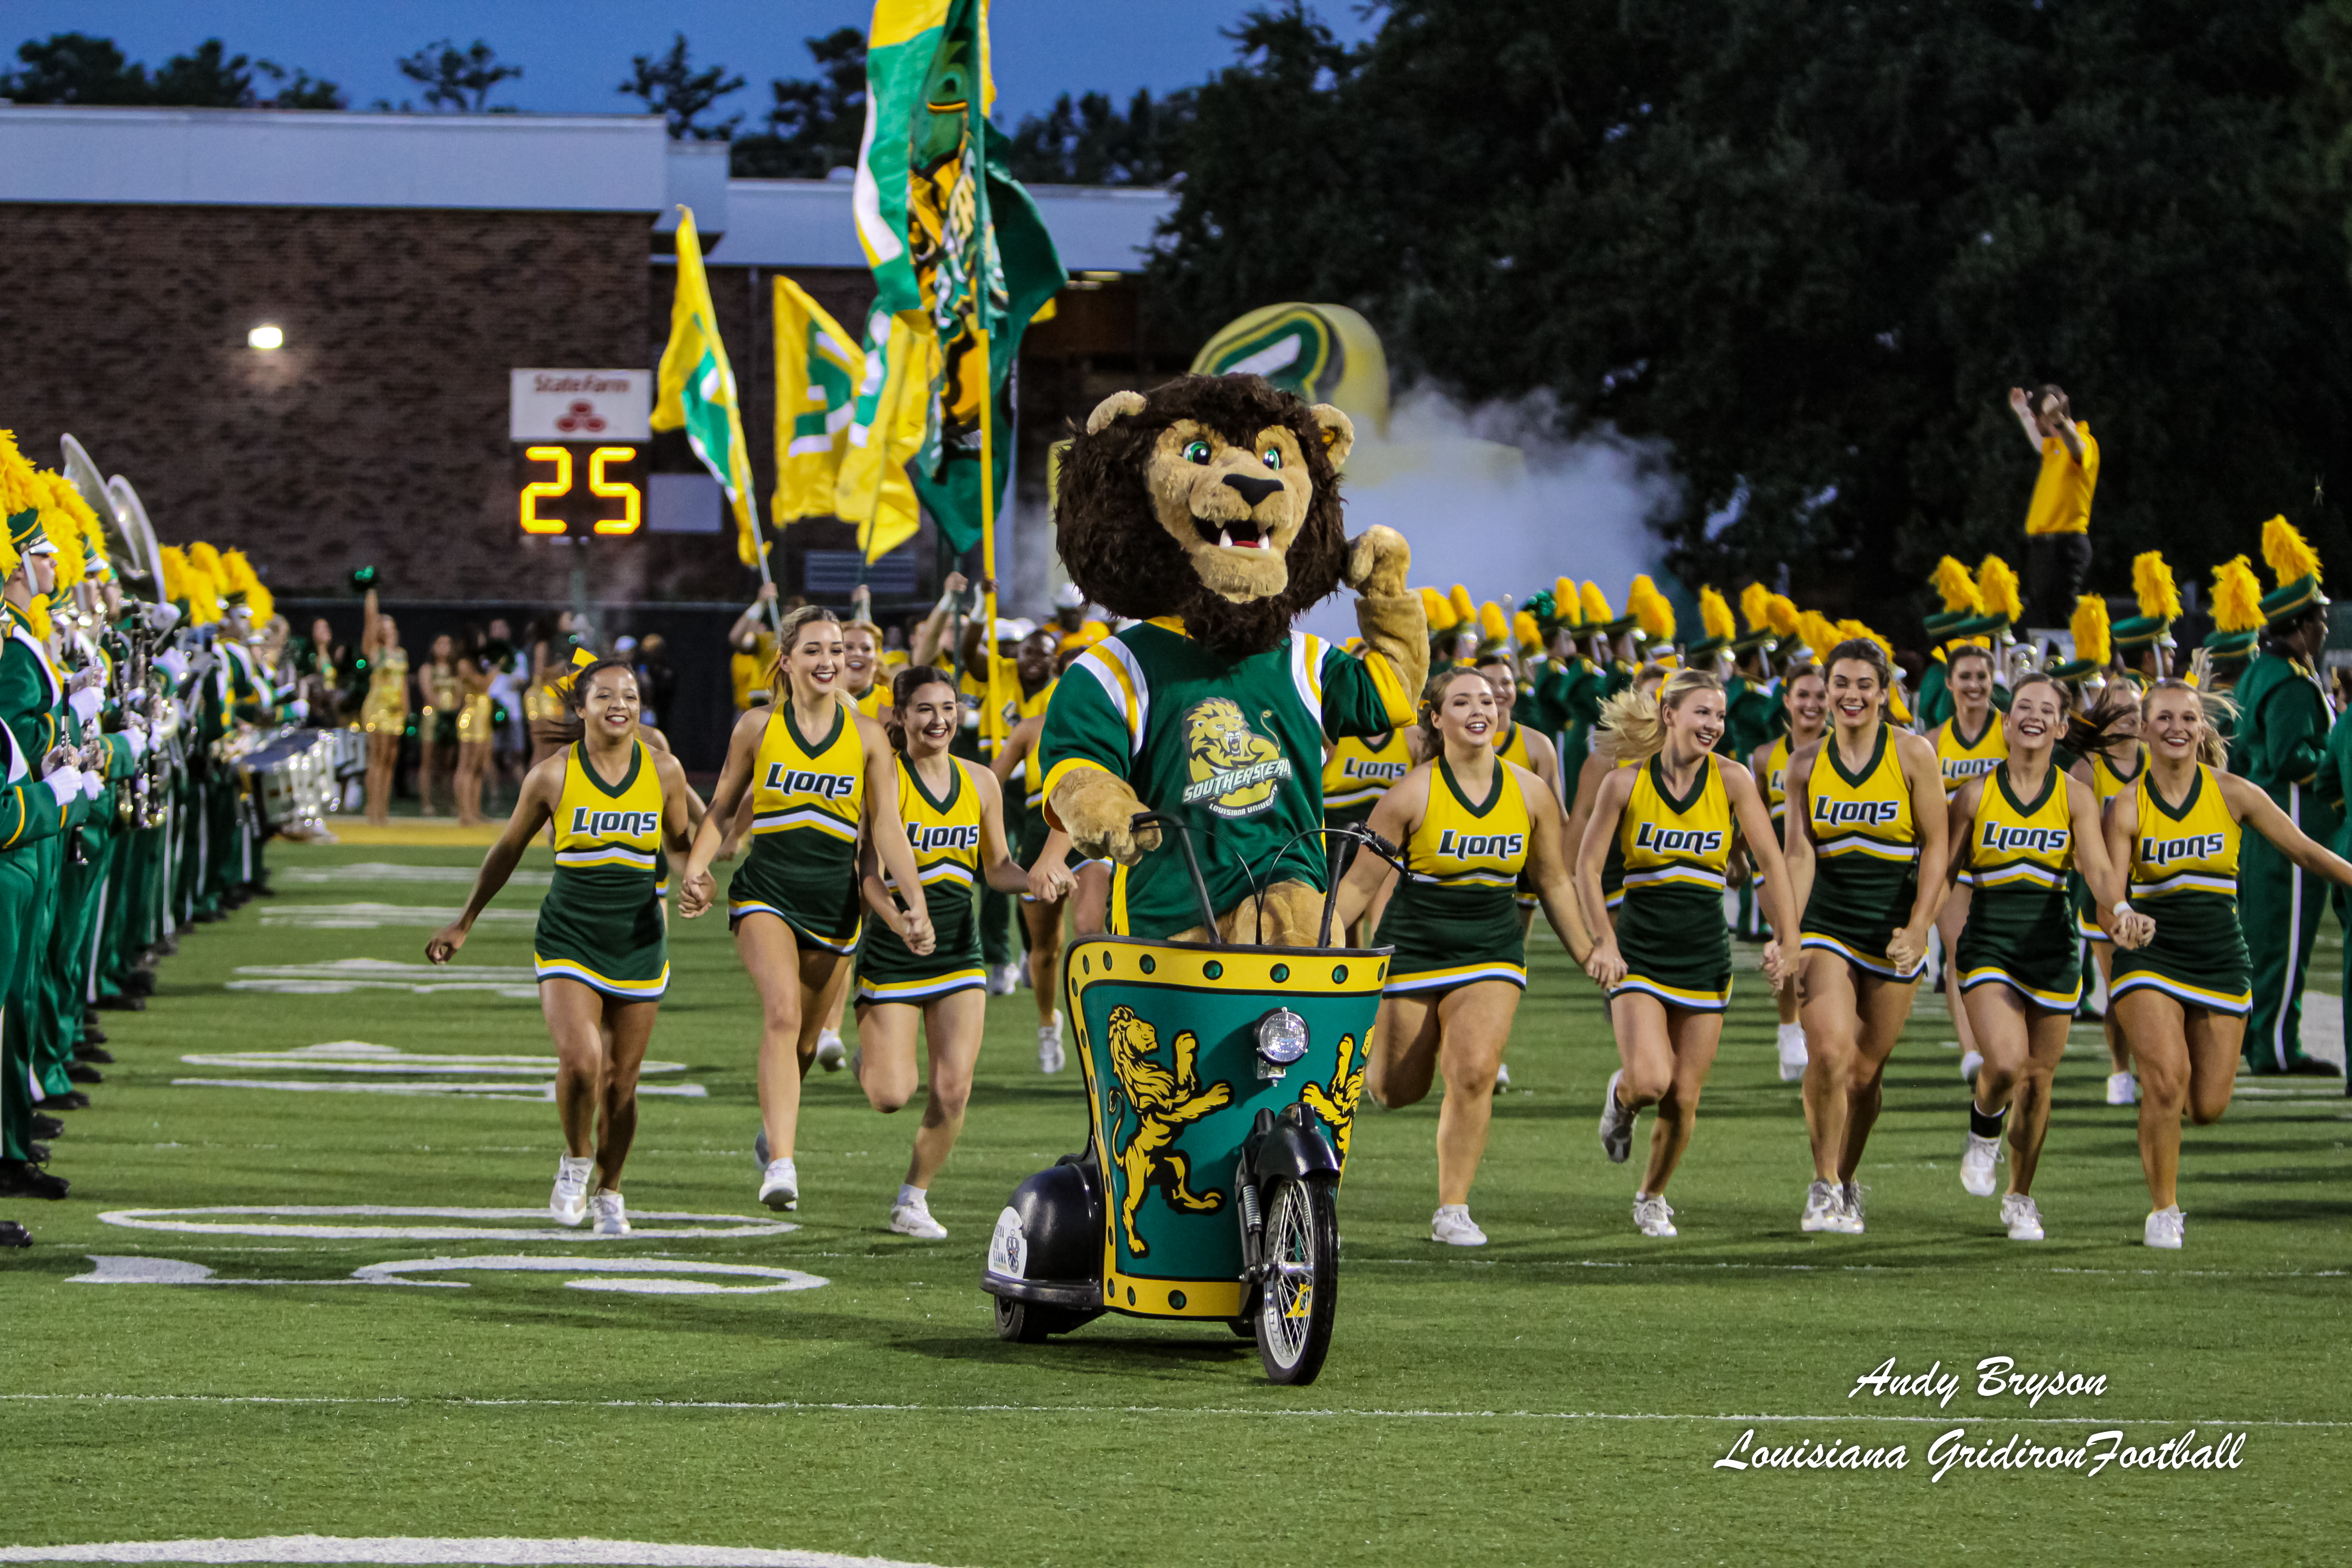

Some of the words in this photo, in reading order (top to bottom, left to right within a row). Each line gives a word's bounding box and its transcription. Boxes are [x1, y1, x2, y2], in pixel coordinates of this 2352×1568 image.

[520, 446, 641, 535] 25
[1183, 759, 1292, 803] SOUTHEASTERN
[1209, 803, 1246, 816] LOUISIANA
